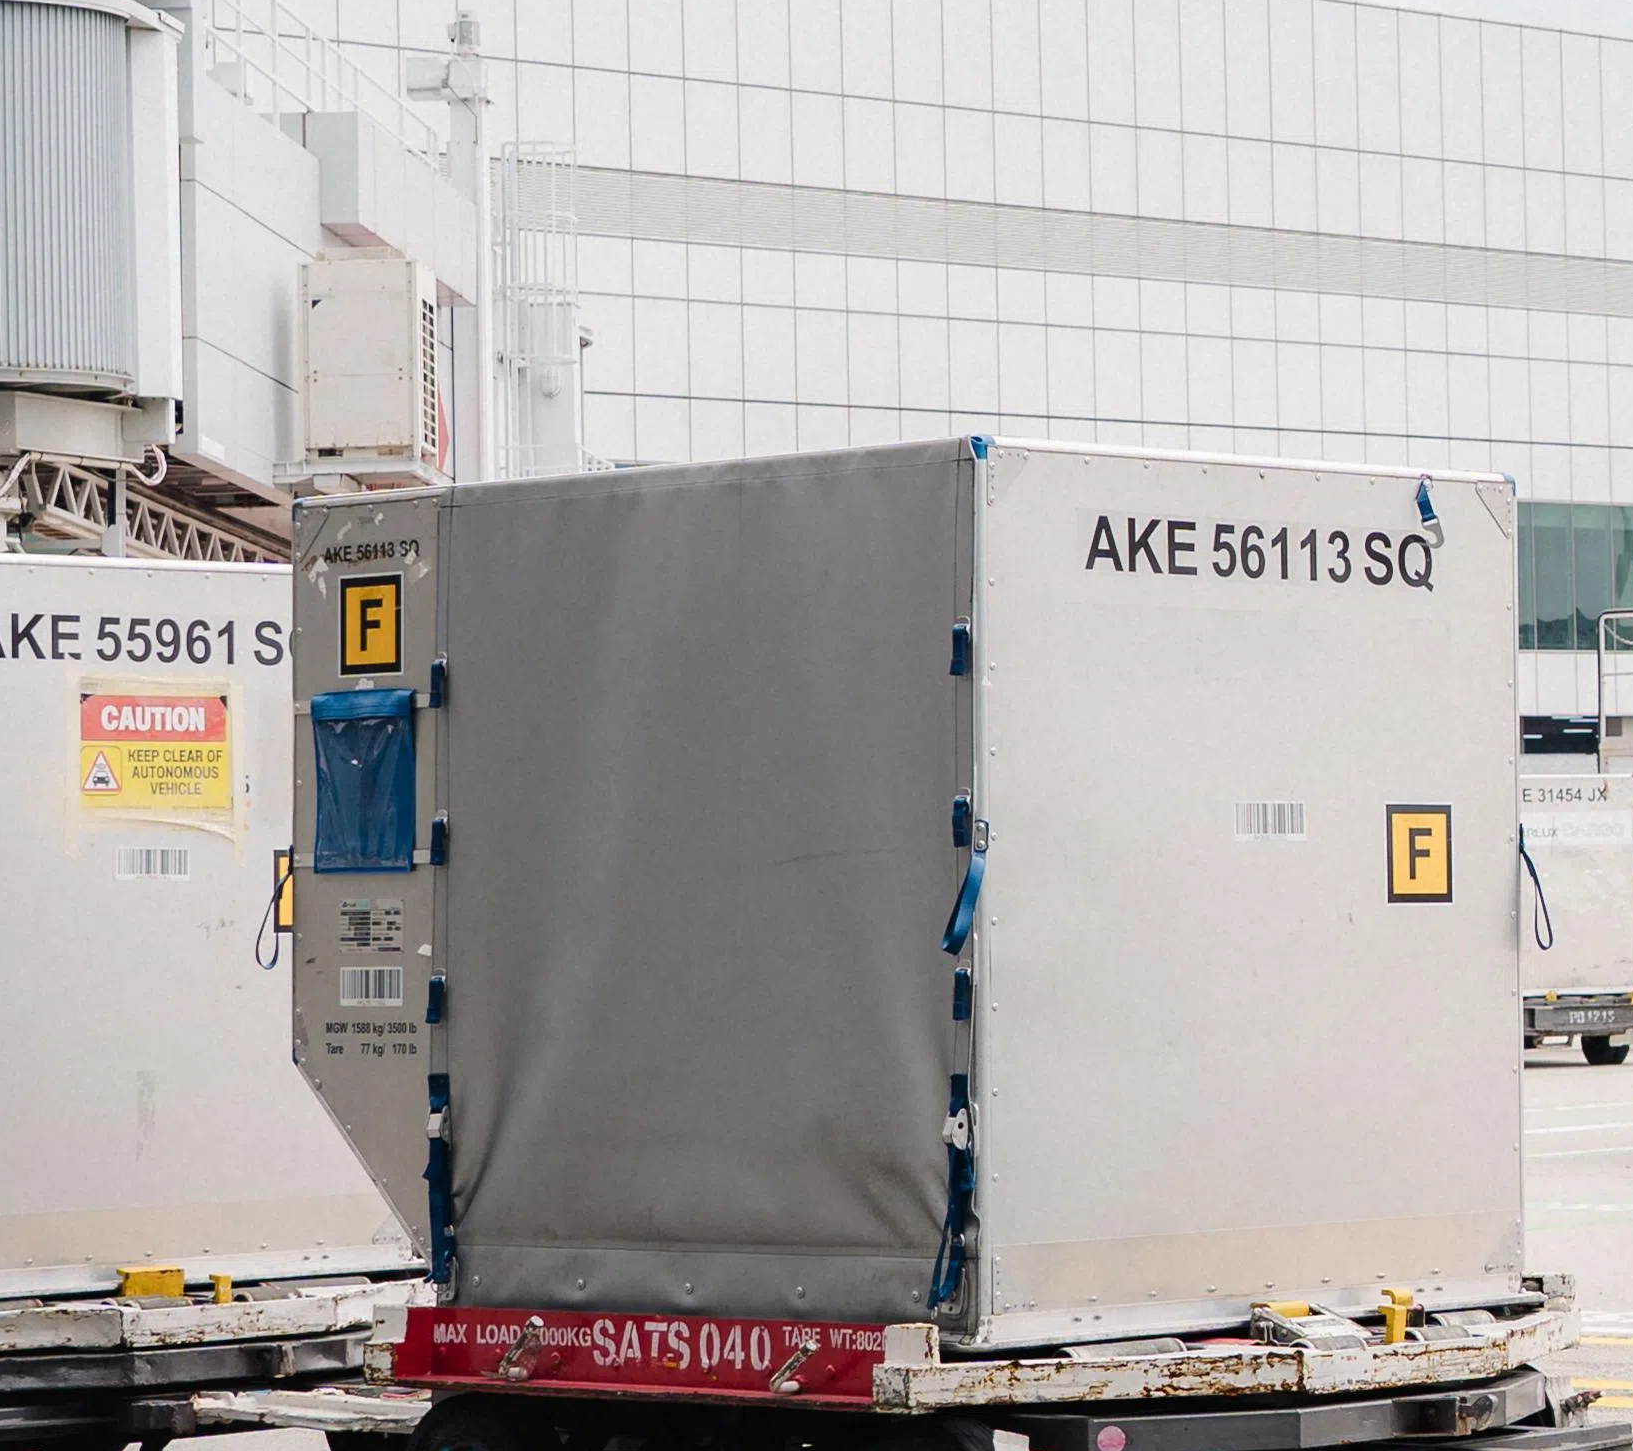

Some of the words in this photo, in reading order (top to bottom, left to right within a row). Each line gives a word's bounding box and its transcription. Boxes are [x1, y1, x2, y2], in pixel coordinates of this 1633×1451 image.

[324, 545, 353, 564] AKE
[355, 541, 395, 562] 56113
[399, 539, 420, 558] SQ
[1085, 515, 1198, 576] AKE
[1212, 523, 1352, 584] 56113
[1364, 531, 1434, 593] SQ
[360, 598, 383, 652] F
[96, 616, 235, 665] 55961
[253, 620, 293, 666] S
[101, 705, 205, 732] CAUTION
[127, 749, 159, 762] KEEP
[162, 749, 203, 763] CLEAR
[207, 749, 223, 763] OF
[132, 766, 219, 779] AUTONOMOUS
[150, 783, 202, 796] VEHICLE
[1538, 788, 1583, 803] 31454
[1588, 788, 1607, 802] JX
[1408, 828, 1433, 880] F
[325, 1022, 348, 1034] MGW
[351, 1022, 370, 1034] 1588
[387, 1022, 407, 1034] 3500
[409, 1022, 417, 1034] lb
[326, 1043, 344, 1055] Tare
[360, 1043, 371, 1055] 77
[392, 1043, 407, 1055] 170
[409, 1043, 417, 1055] lb
[433, 1323, 467, 1344] MAX
[476, 1323, 519, 1345] LOAD
[539, 1326, 592, 1347] 000KG
[592, 1317, 691, 1370] SATS
[699, 1322, 772, 1372] 040
[782, 1326, 821, 1349] TARE
